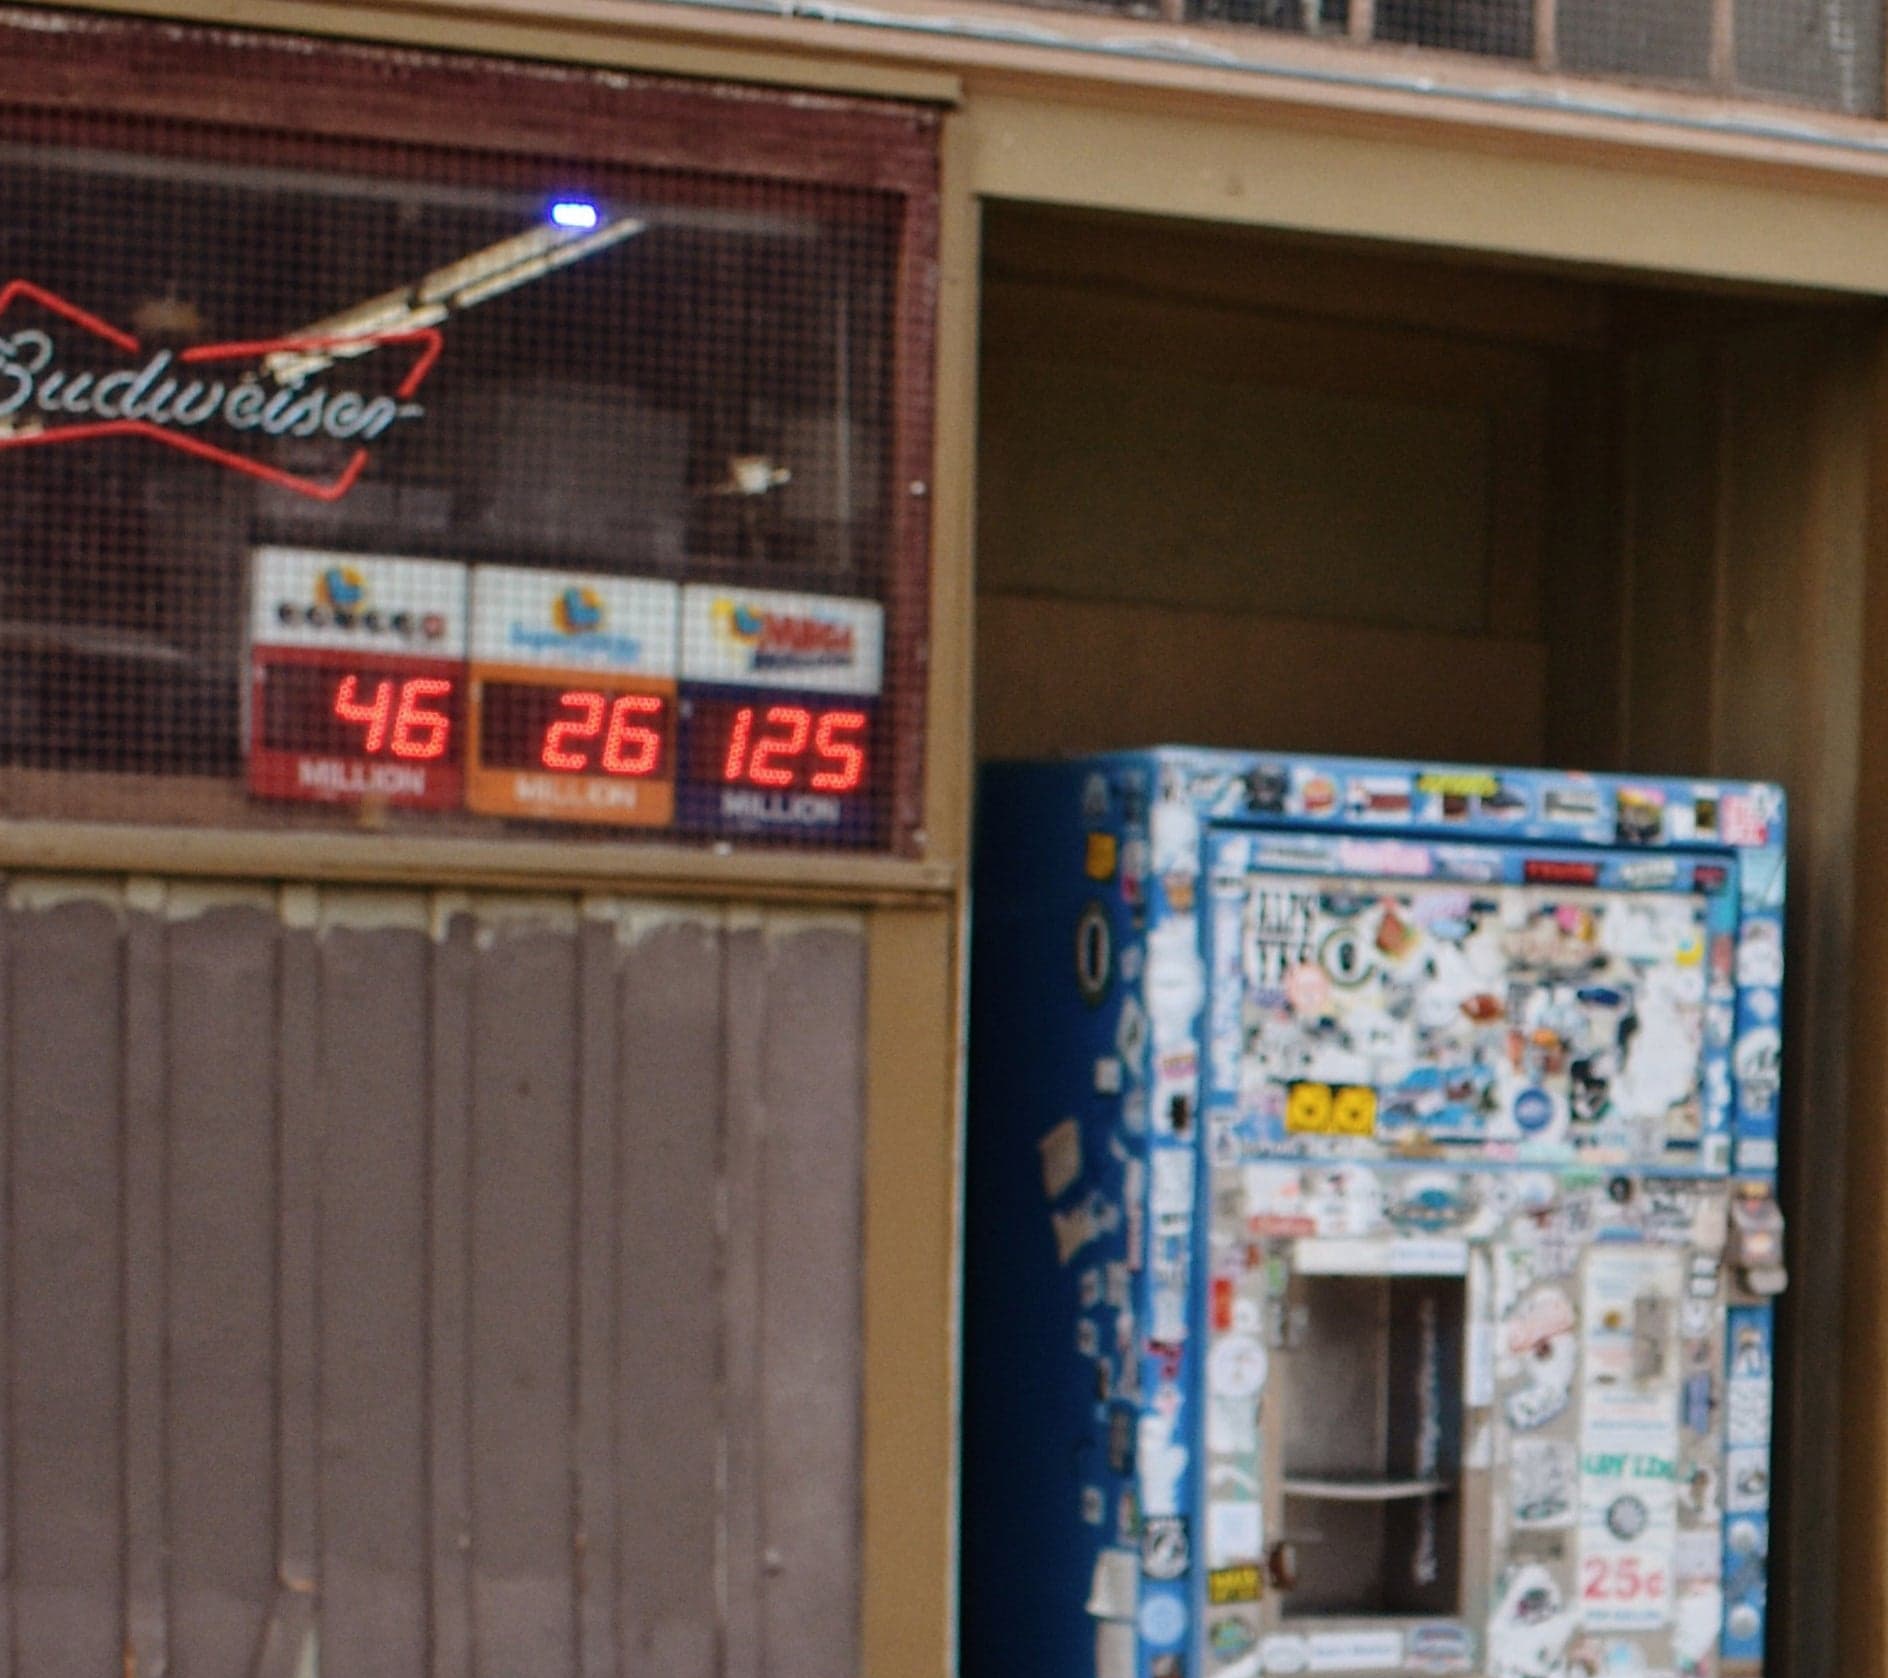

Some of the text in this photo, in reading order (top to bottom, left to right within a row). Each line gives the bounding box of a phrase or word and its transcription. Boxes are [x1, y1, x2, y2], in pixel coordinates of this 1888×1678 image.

[0, 328, 424, 440] Budweiser
[333, 674, 453, 760] 46
[541, 690, 663, 775] 26
[723, 706, 867, 791] 125
[298, 760, 427, 797] MILLION
[513, 773, 638, 812] MILLION
[719, 790, 841, 827] MILLION
